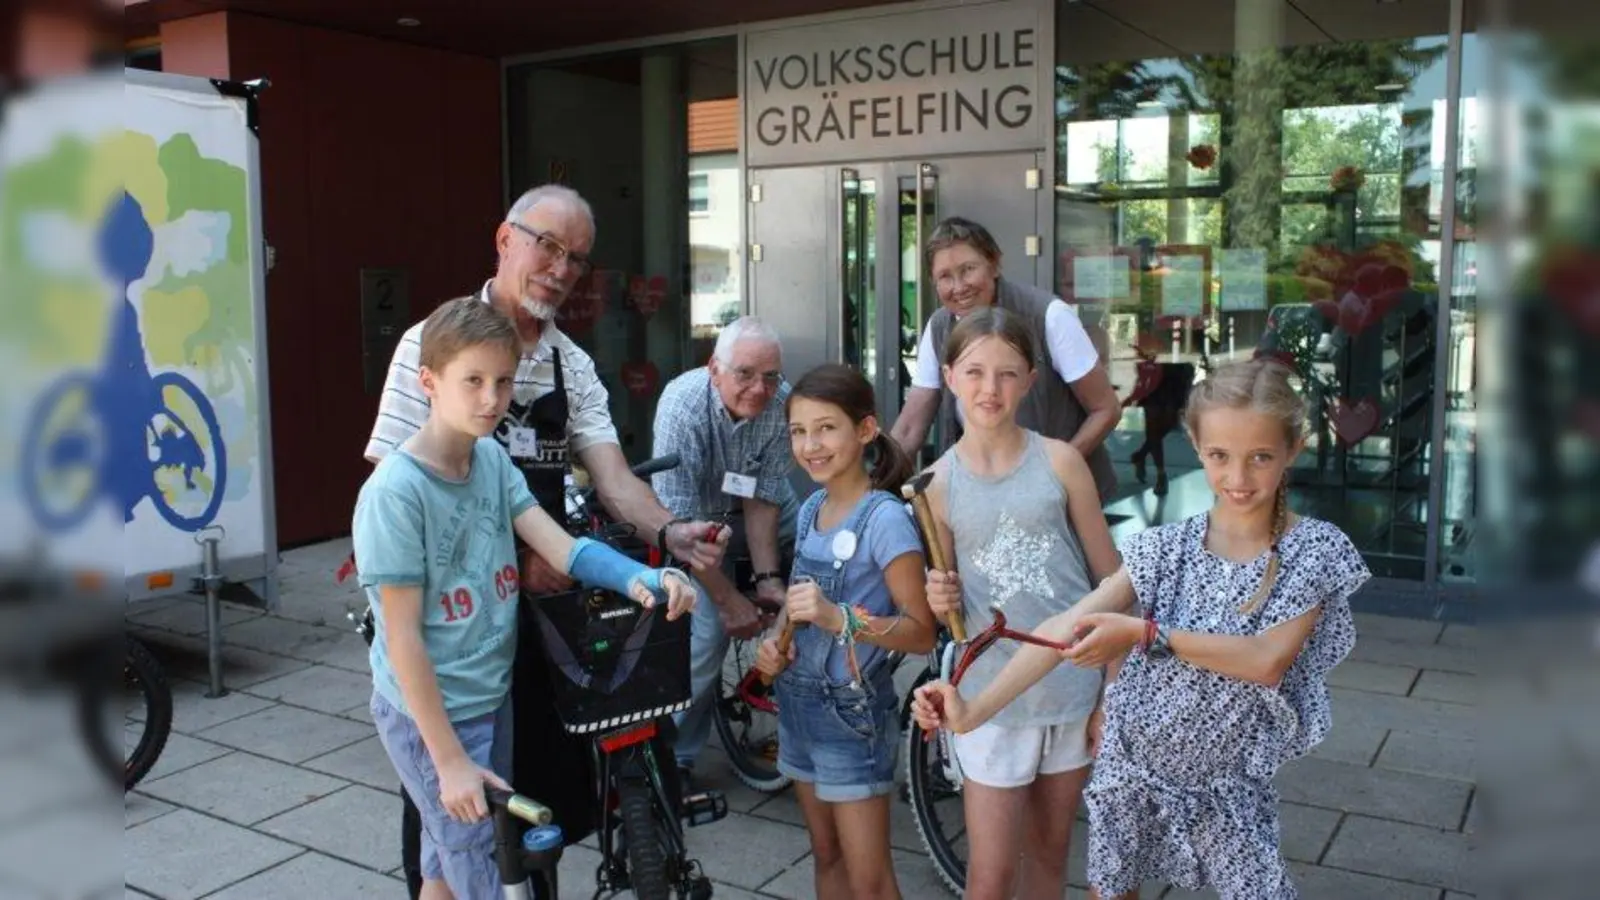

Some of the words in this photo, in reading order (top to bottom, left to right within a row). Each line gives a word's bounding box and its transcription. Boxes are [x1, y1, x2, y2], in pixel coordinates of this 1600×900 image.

[754, 28, 1034, 93] VOLKSSCHULE
[756, 84, 1033, 146] GRÄFELFING
[376, 278, 394, 310] 2
[440, 587, 473, 622] 19
